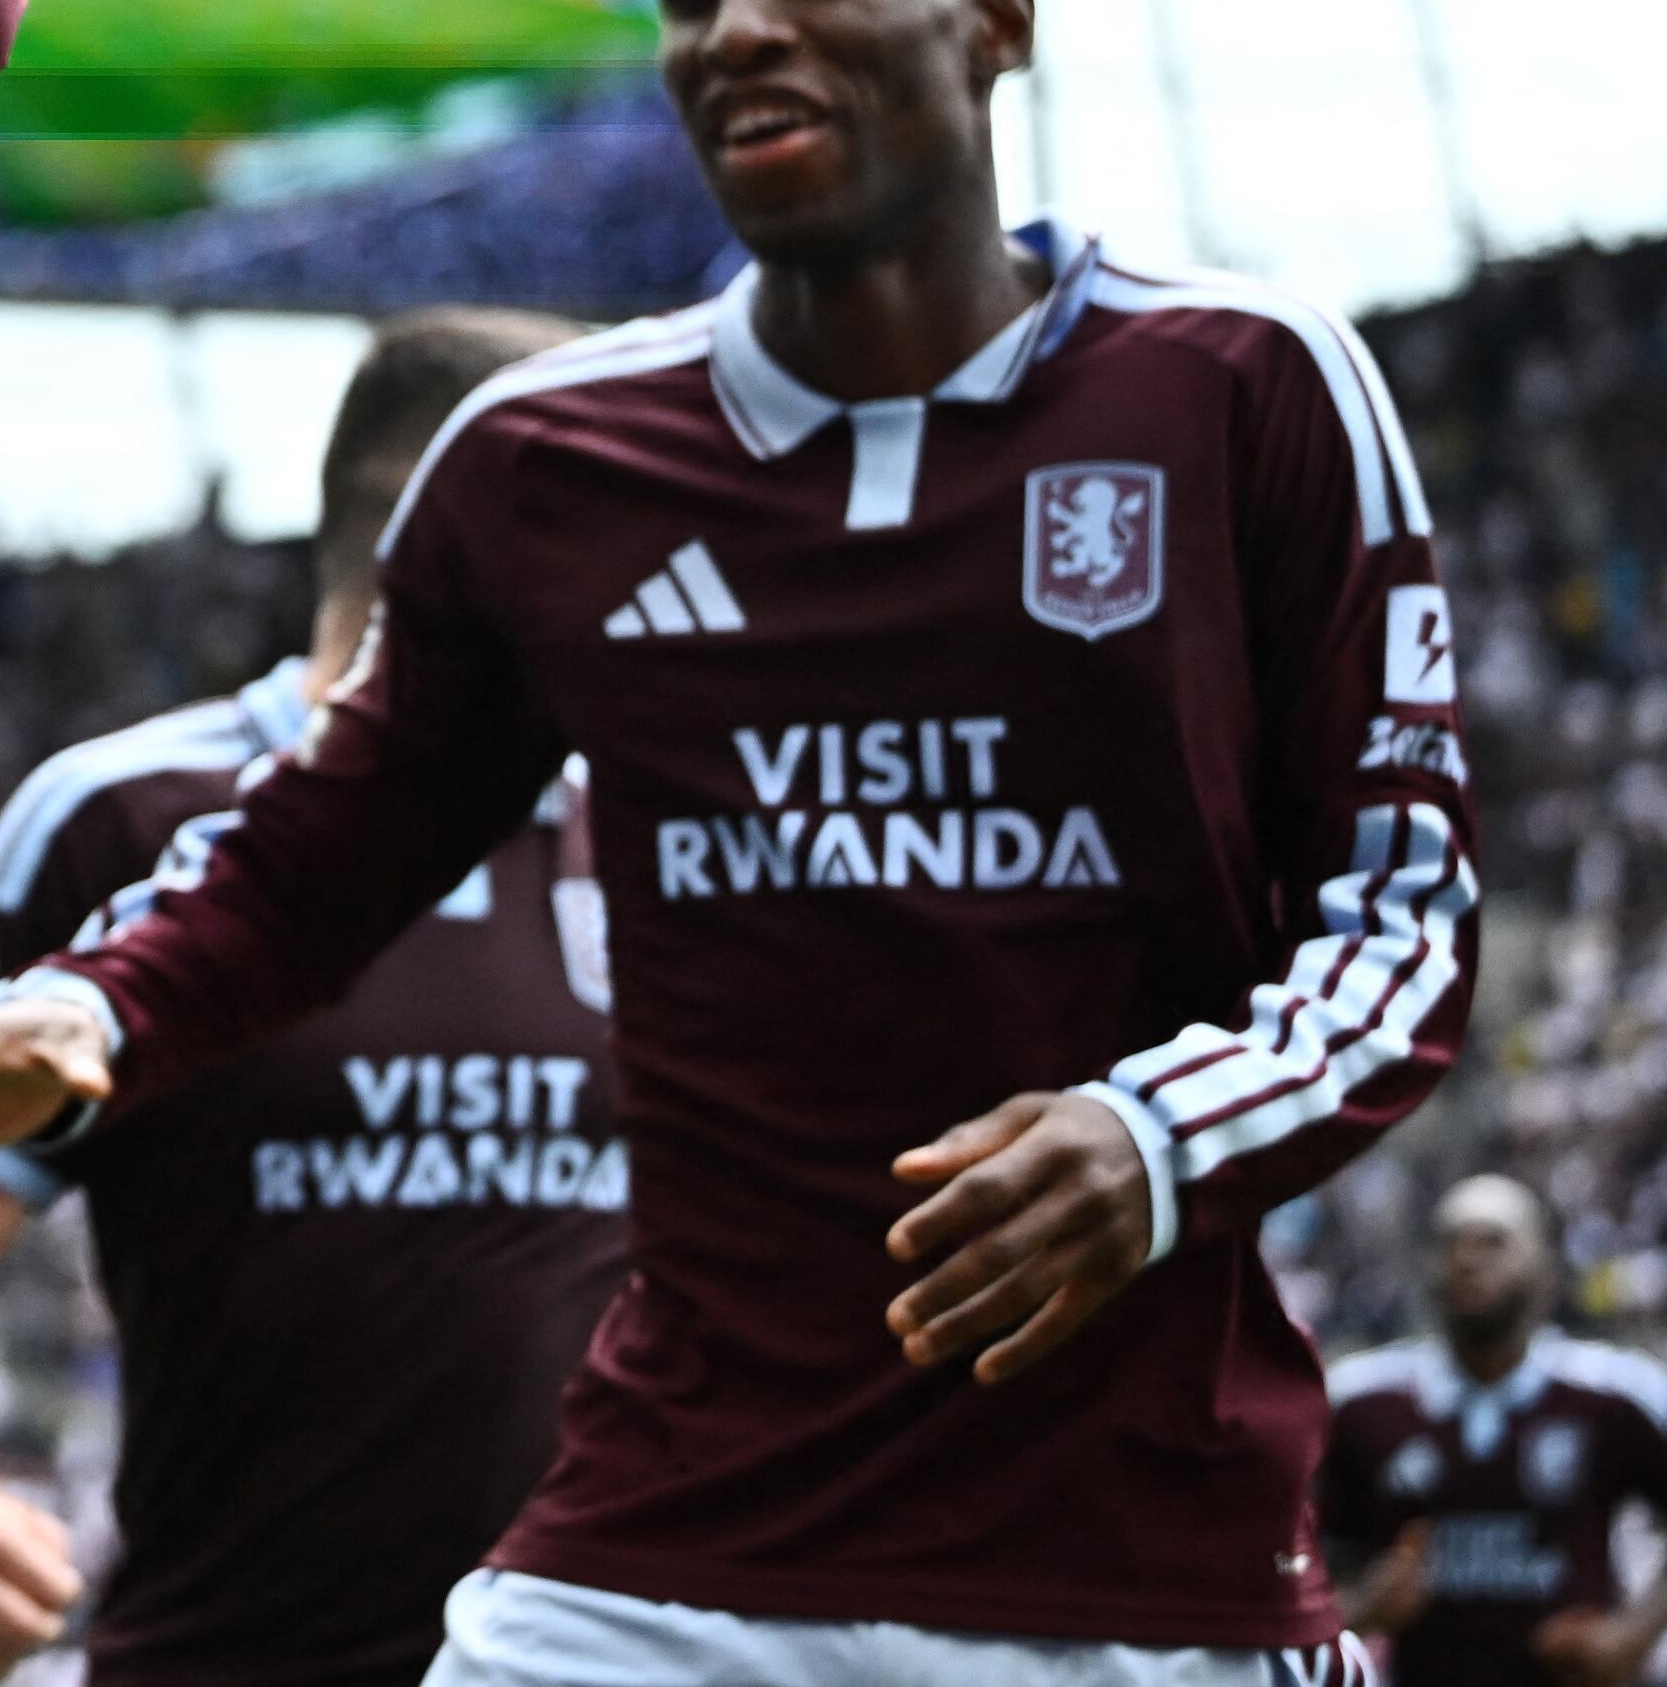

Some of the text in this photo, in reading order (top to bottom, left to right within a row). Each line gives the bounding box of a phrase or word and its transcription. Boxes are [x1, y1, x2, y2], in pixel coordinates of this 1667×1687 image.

[733, 717, 1007, 808] VISIT
[656, 807, 1120, 898] RWANDA
[342, 1054, 590, 1131] VISIT
[252, 1130, 632, 1211] RWANDA
